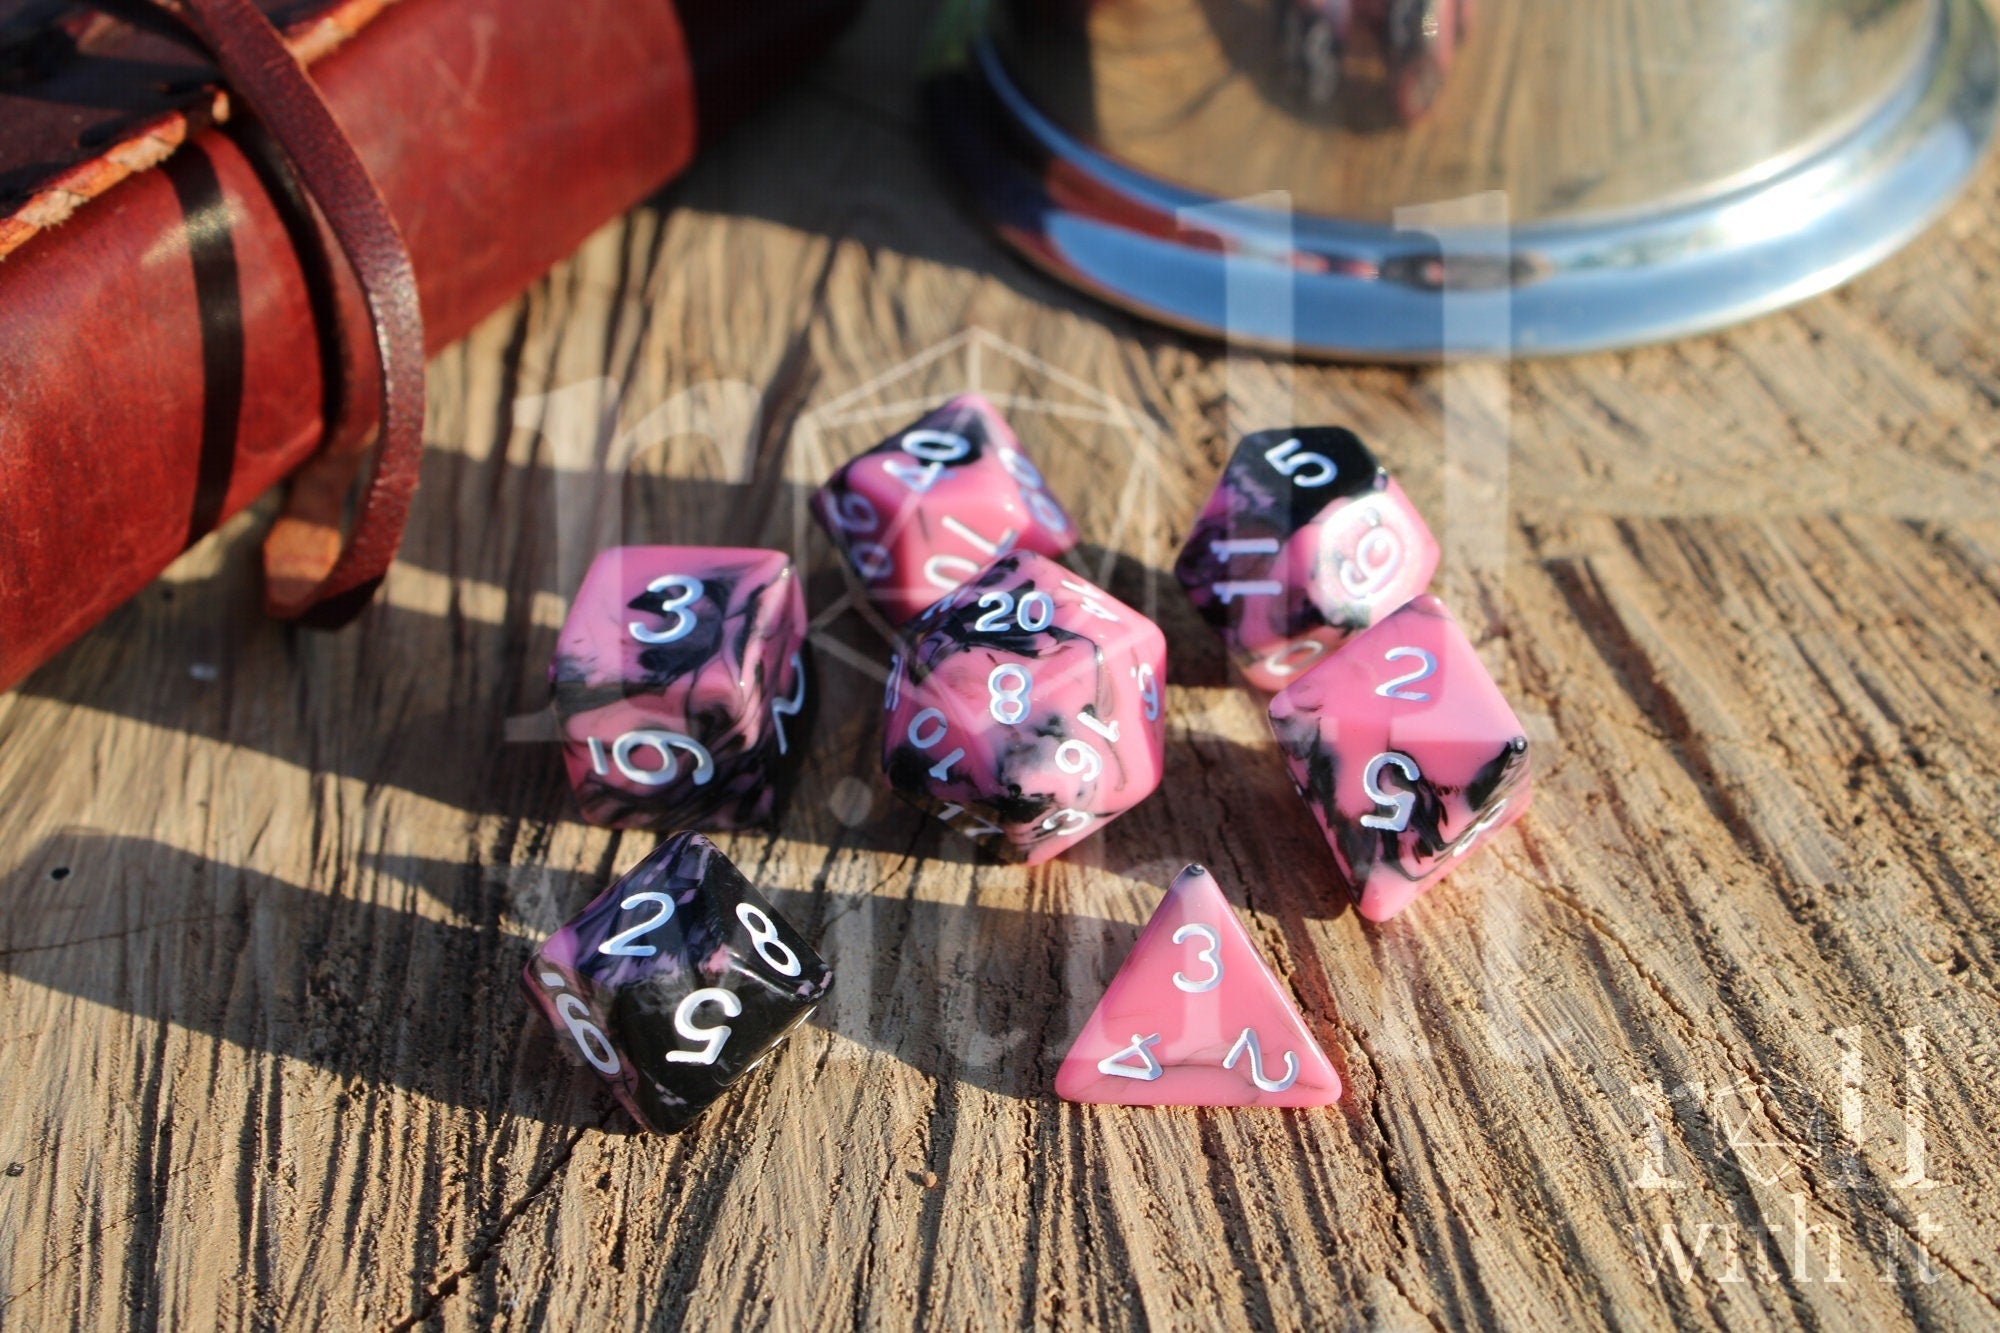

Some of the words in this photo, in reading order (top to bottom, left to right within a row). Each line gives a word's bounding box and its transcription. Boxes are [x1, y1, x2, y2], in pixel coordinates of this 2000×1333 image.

[1264, 438, 1338, 488] 5
[1209, 537, 1284, 605] 11
[628, 573, 705, 644] 3
[974, 590, 1055, 633] 20
[987, 662, 1034, 725] 8
[1375, 646, 1438, 702] 2
[1054, 710, 1120, 783] 16
[1042, 807, 1095, 836] 3
[1359, 750, 1421, 832] 5
[597, 891, 676, 957] 2
[735, 902, 802, 977] 8
[1172, 923, 1224, 993] 3
[664, 987, 743, 1066] 5
[1096, 1032, 1164, 1081] 4
[1222, 1027, 1299, 1093] 2
